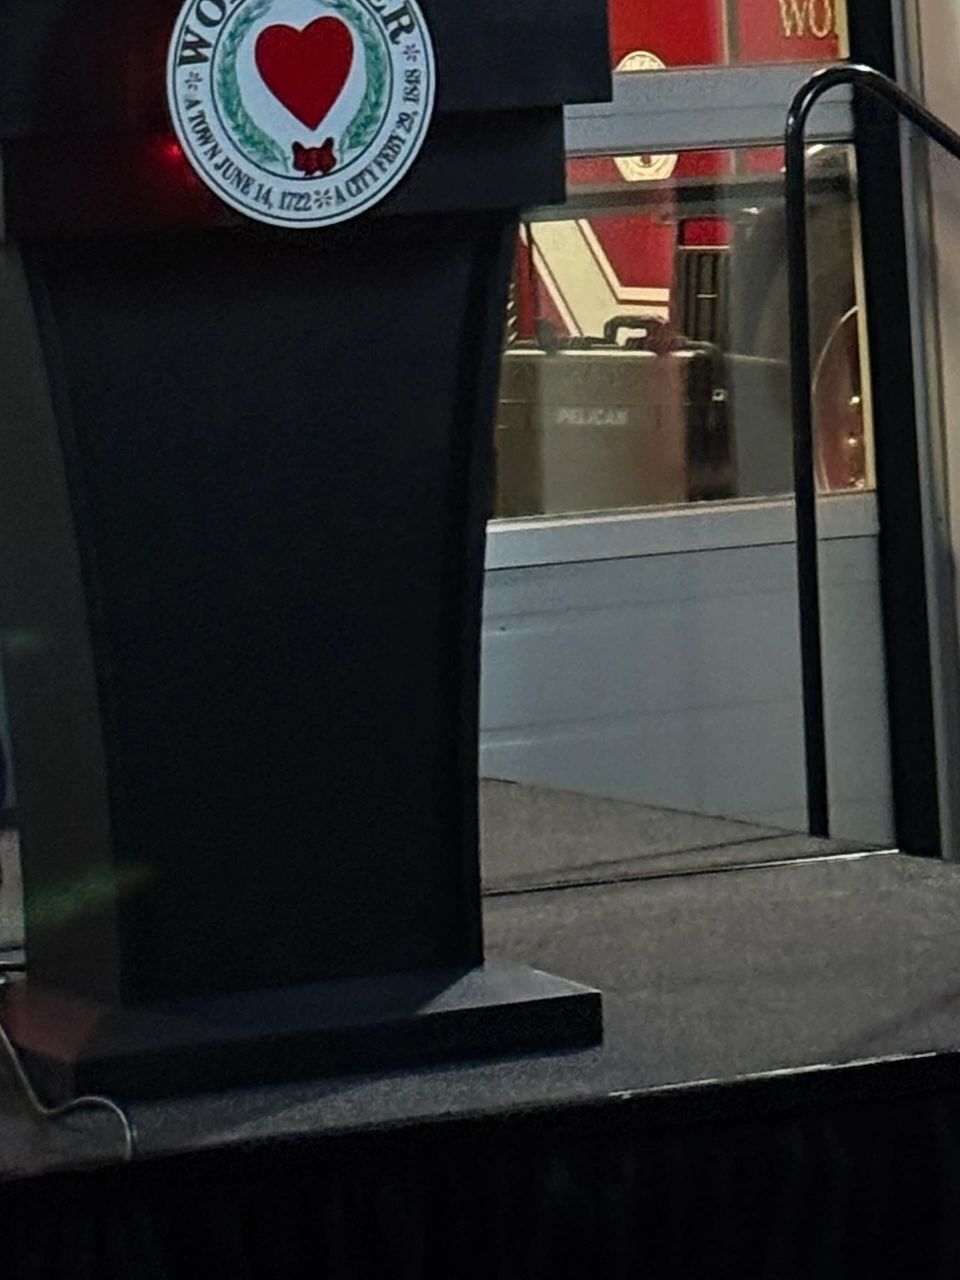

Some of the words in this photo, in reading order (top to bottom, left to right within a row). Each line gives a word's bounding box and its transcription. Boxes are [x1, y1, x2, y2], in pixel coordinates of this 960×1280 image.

[185, 99, 201, 111] A
[187, 109, 222, 160] TOWN
[334, 185, 347, 203] A
[345, 164, 380, 198] CITY
[403, 68, 421, 106] 1848
[213, 156, 255, 196] JUNE
[278, 190, 312, 212] 1722
